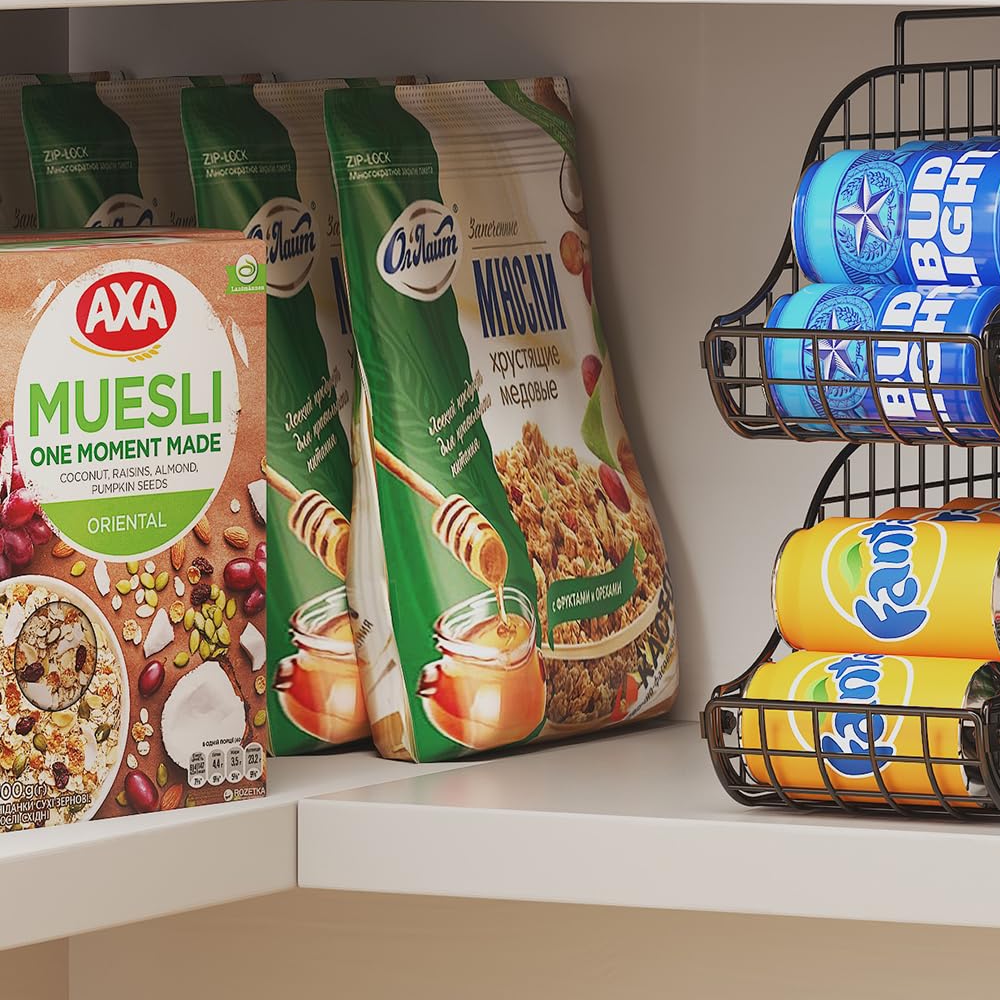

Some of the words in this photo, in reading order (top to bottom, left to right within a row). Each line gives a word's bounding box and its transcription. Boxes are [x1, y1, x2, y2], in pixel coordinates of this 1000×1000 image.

[43, 146, 89, 162] ZIP-LOCK
[203, 150, 248, 166] ZIP-LOCK
[345, 152, 391, 168] ZIP-LOCK
[908, 156, 952, 282] BUD
[940, 150, 998, 287] IGHT
[85, 281, 168, 334] AXA
[489, 345, 561, 374] хрустящие
[877, 292, 922, 417] BUD
[29, 370, 222, 437] MUESLI
[499, 377, 559, 409] медовые
[30, 445, 72, 467] ONE
[78, 437, 162, 464] MOMENT
[167, 432, 221, 456] MADE
[60, 469, 110, 483] COCONUT,
[113, 465, 152, 480] RAISINS,
[155, 462, 199, 476] ALMOND,
[92, 480, 135, 495] PUMPKIN
[137, 479, 168, 491] SEEDS
[88, 511, 167, 534] ORIENTAL
[854, 519, 928, 640] Fant
[556, 590, 590, 610] ФРУКТАМИ
[595, 582, 622, 601] ОРЕХАМИ
[821, 654, 894, 777] Fant
[234, 787, 266, 796] ROZETKA
